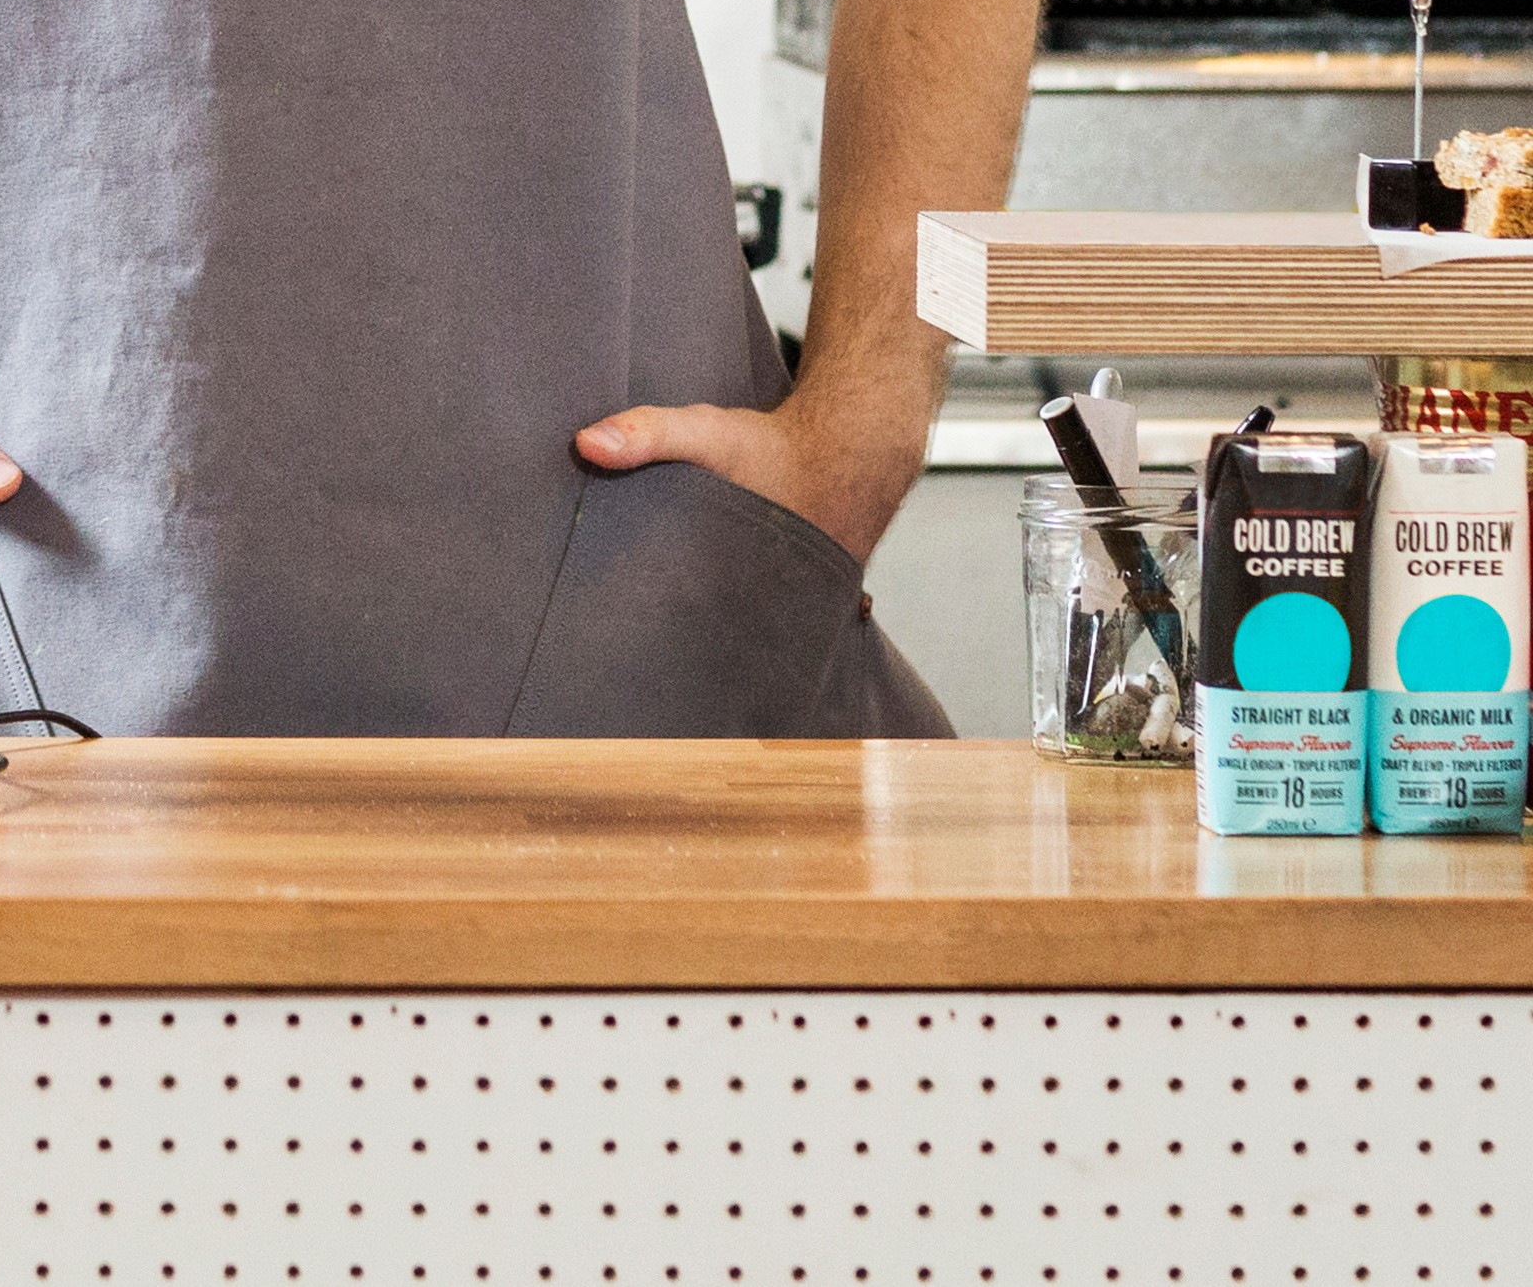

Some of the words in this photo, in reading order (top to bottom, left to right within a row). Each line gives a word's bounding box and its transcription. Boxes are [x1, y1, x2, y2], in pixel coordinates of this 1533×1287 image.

[1234, 517, 1290, 554] COLD
[1295, 519, 1355, 554] BREW
[1395, 520, 1448, 553] COLD
[1457, 520, 1514, 553] BREW
[1245, 557, 1345, 577] COFFEE
[1407, 559, 1504, 576] COFFEE
[1231, 706, 1302, 725] STRAIGHT
[1308, 708, 1350, 725] BLACK
[1392, 707, 1404, 725] &
[1409, 708, 1476, 726] ORGANIC
[1480, 708, 1514, 725] MILK
[1218, 756, 1248, 771] SINGLE
[1250, 758, 1285, 771] ORIGIN
[1293, 758, 1325, 772] TRIPLE
[1380, 757, 1410, 772] CRAFT
[1412, 759, 1444, 772] BLEND
[1452, 759, 1485, 772] TRIPLE
[1236, 786, 1278, 799] BREWED
[1282, 776, 1306, 809] 18
[1310, 787, 1343, 800] HOURS
[1398, 786, 1441, 799] BREWED
[1444, 776, 1468, 809] 18
[1472, 786, 1506, 800] HOURS
